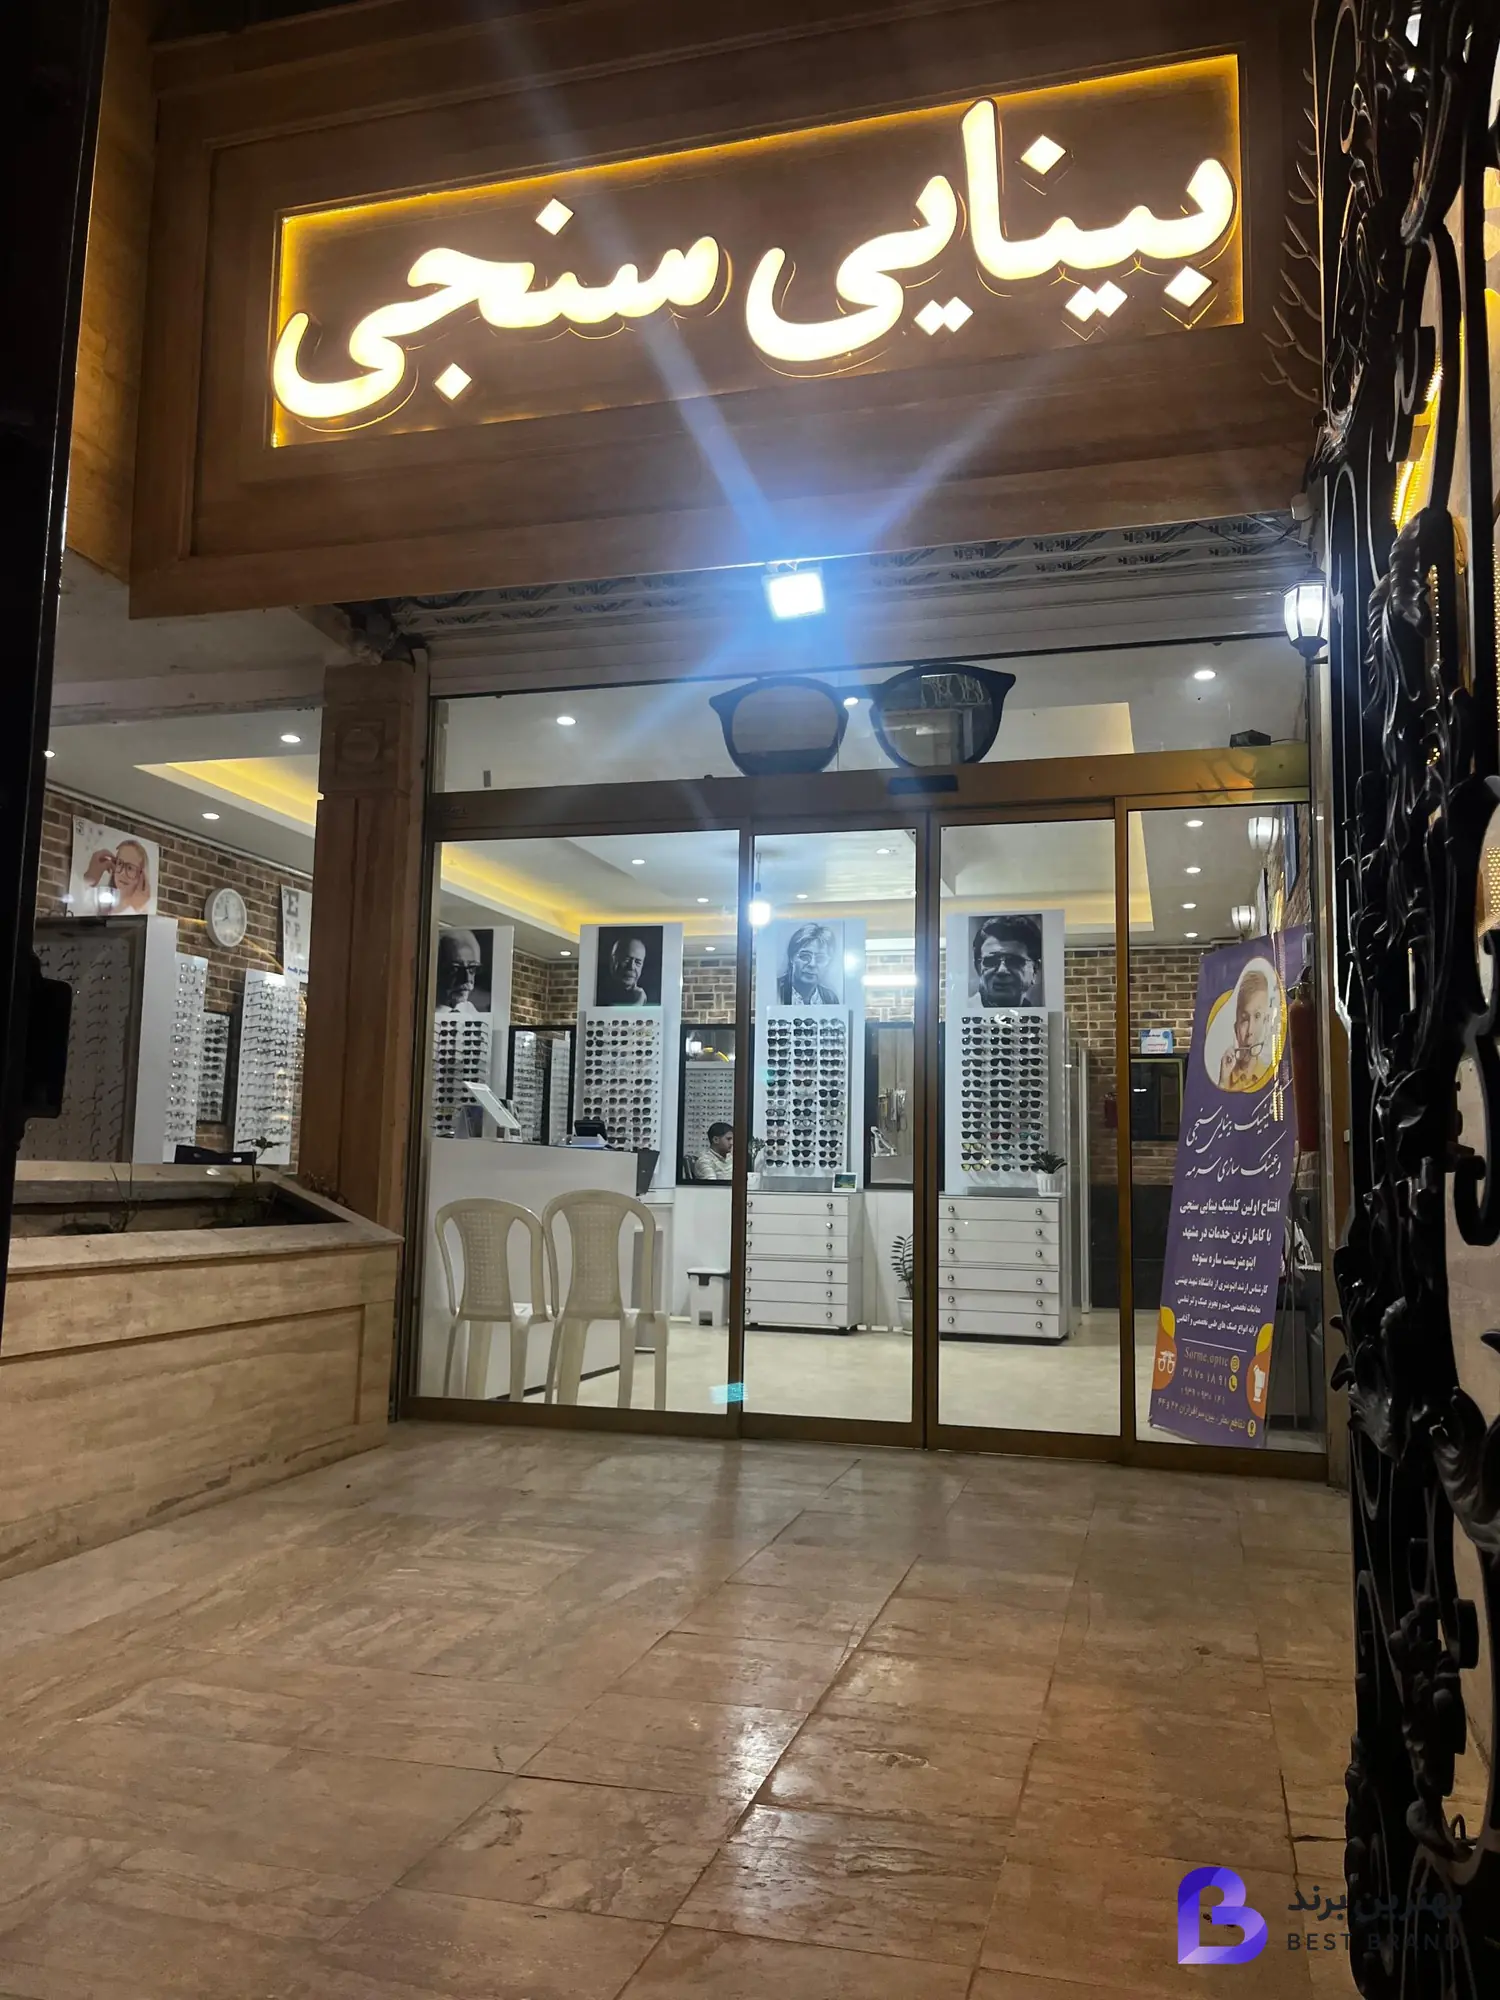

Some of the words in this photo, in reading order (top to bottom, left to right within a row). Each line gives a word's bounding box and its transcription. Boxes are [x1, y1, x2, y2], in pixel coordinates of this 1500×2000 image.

[745, 98, 1235, 364] بینایی
[272, 197, 720, 420] سنجی
[1186, 1105, 1222, 1147] سنجی
[1195, 1113, 1233, 1154] بینایی
[1240, 1130, 1287, 1179] عینک
[1217, 1157, 1240, 1182] سازی
[1179, 1199, 1199, 1214] سنجی
[1200, 1199, 1218, 1215] بینایی
[1218, 1198, 1241, 1215] کلینیک
[1241, 1198, 1260, 1216] اولین
[1261, 1198, 1281, 1216] افتتاح
[1182, 1225, 1198, 1241] مشهد
[1199, 1227, 1208, 1242] در
[1209, 1225, 1231, 1240] خدمات
[1231, 1227, 1248, 1244] ترین
[1248, 1228, 1265, 1244] کامل
[1266, 1229, 1272, 1246] با
